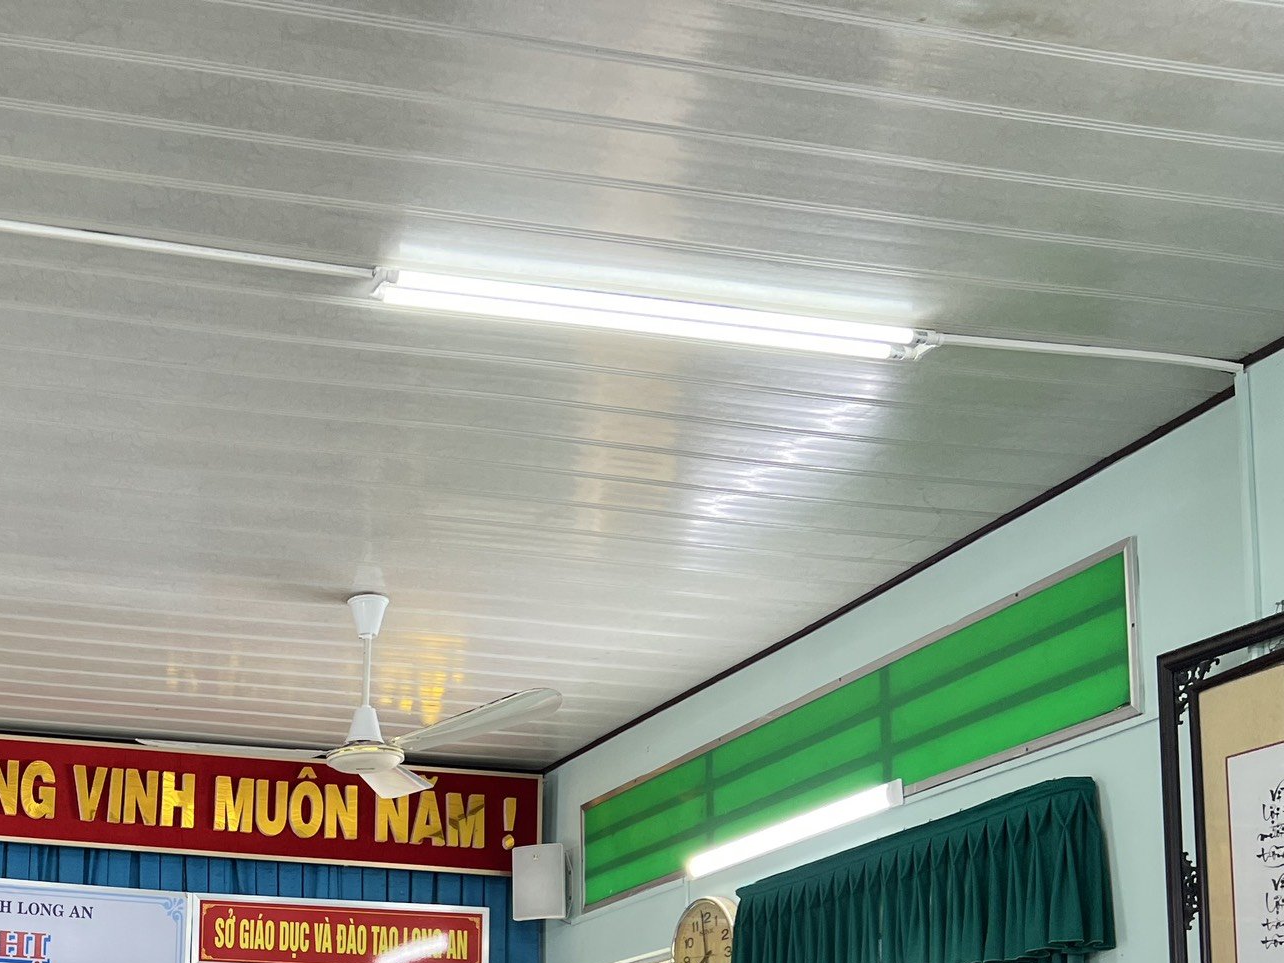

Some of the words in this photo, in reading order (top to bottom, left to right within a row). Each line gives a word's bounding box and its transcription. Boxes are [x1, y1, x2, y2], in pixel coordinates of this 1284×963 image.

[73, 764, 195, 828] VINH
[213, 766, 358, 840] MUÔN
[374, 775, 485, 849] NĂM
[18, 901, 64, 917] LONG
[69, 905, 94, 919] AN
[215, 908, 236, 948] SỞ
[240, 914, 275, 950] GIÁO
[279, 921, 310, 958] DỤC
[314, 917, 332, 953] VÀ
[336, 918, 367, 955] ĐÀO
[446, 929, 468, 960] AN
